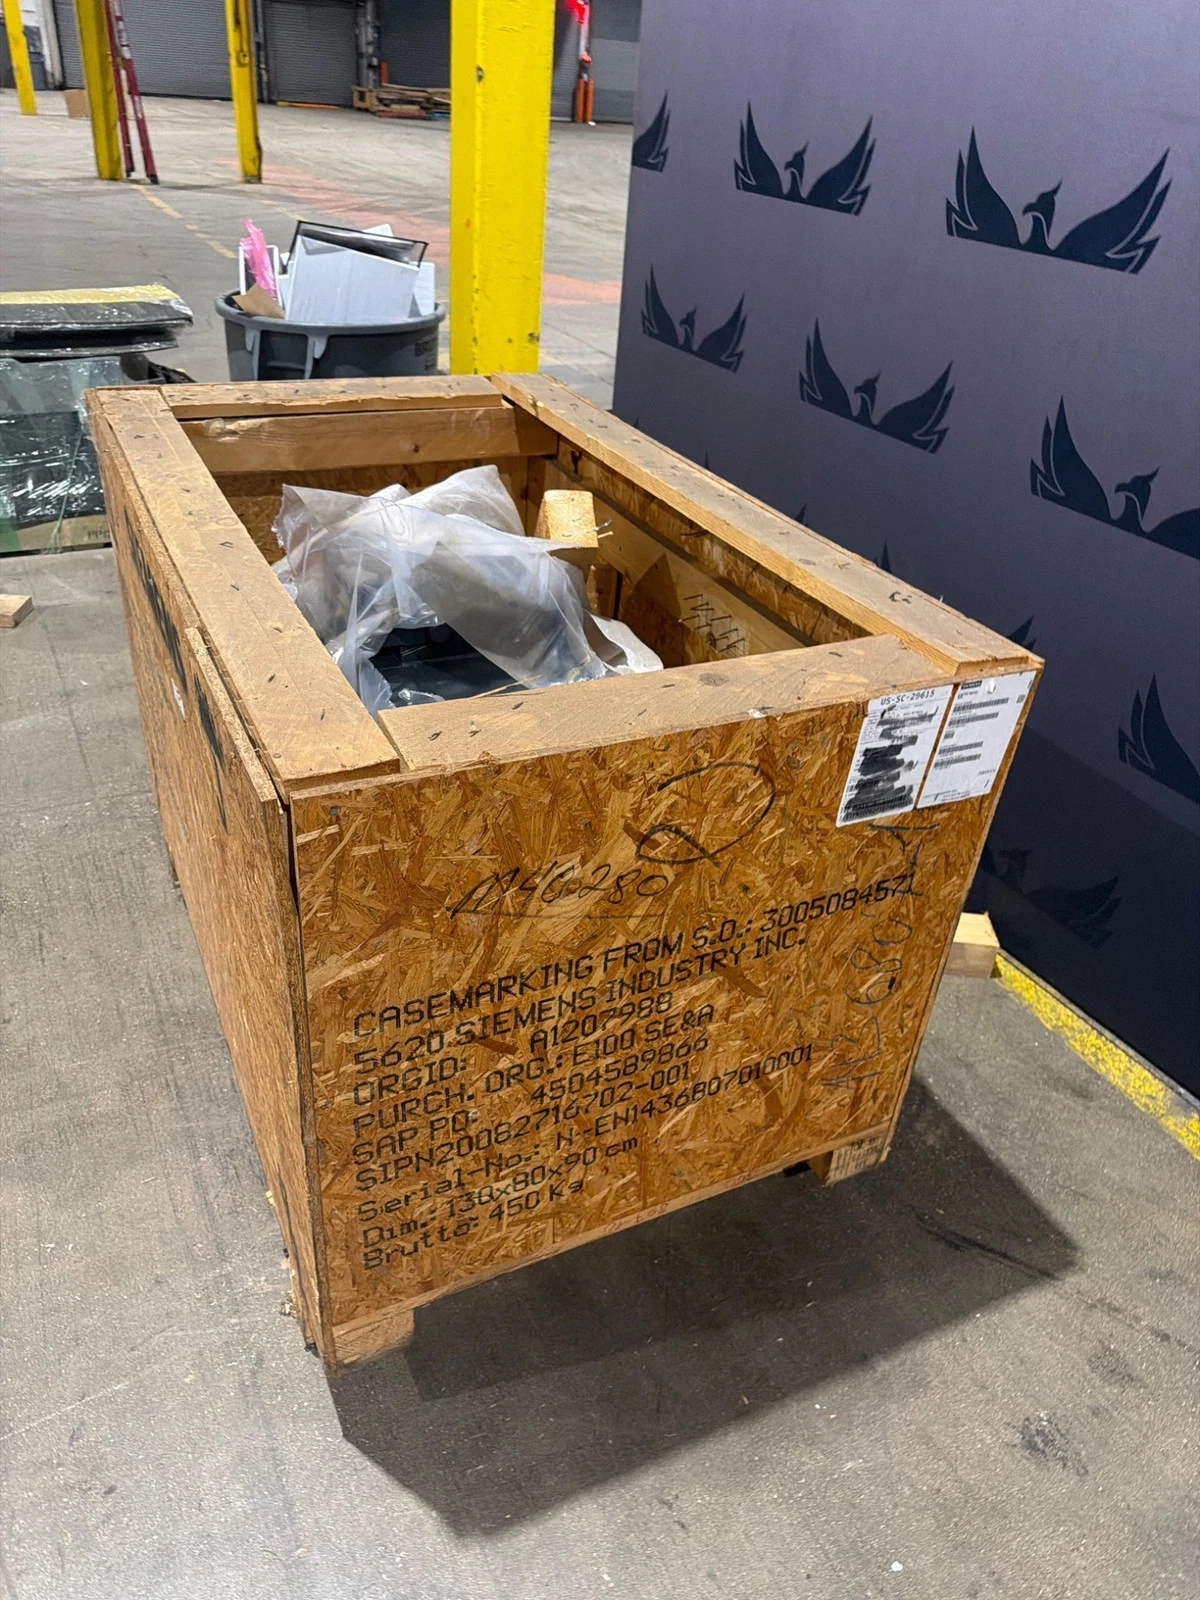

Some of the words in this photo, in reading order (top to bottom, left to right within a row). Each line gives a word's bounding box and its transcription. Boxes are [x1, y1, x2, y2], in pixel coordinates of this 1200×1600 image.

[881, 689, 935, 706] US-SC-29615
[354, 955, 593, 1039] CASEMARKING
[603, 932, 684, 973] FROM
[760, 872, 914, 933] 3005084571
[354, 1031, 444, 1075] 5620
[456, 986, 597, 1046] SIEMENS
[605, 943, 746, 1003] INDUSTRY
[753, 927, 805, 960] INC.
[352, 1129, 418, 1166] SAP
[430, 1109, 478, 1142] PO:
[531, 1031, 708, 1104] 4504589866
[354, 1055, 467, 1106] ORGID:
[530, 991, 673, 1053] A1207988
[354, 1082, 476, 1140] PURCH.
[485, 1054, 563, 1094] ORG.:
[572, 1028, 636, 1066] E100
[644, 1004, 715, 1043] SE&A
[605, 1137, 637, 1157] cm
[363, 1216, 479, 1270] Brutto:
[489, 1190, 541, 1222] 450
